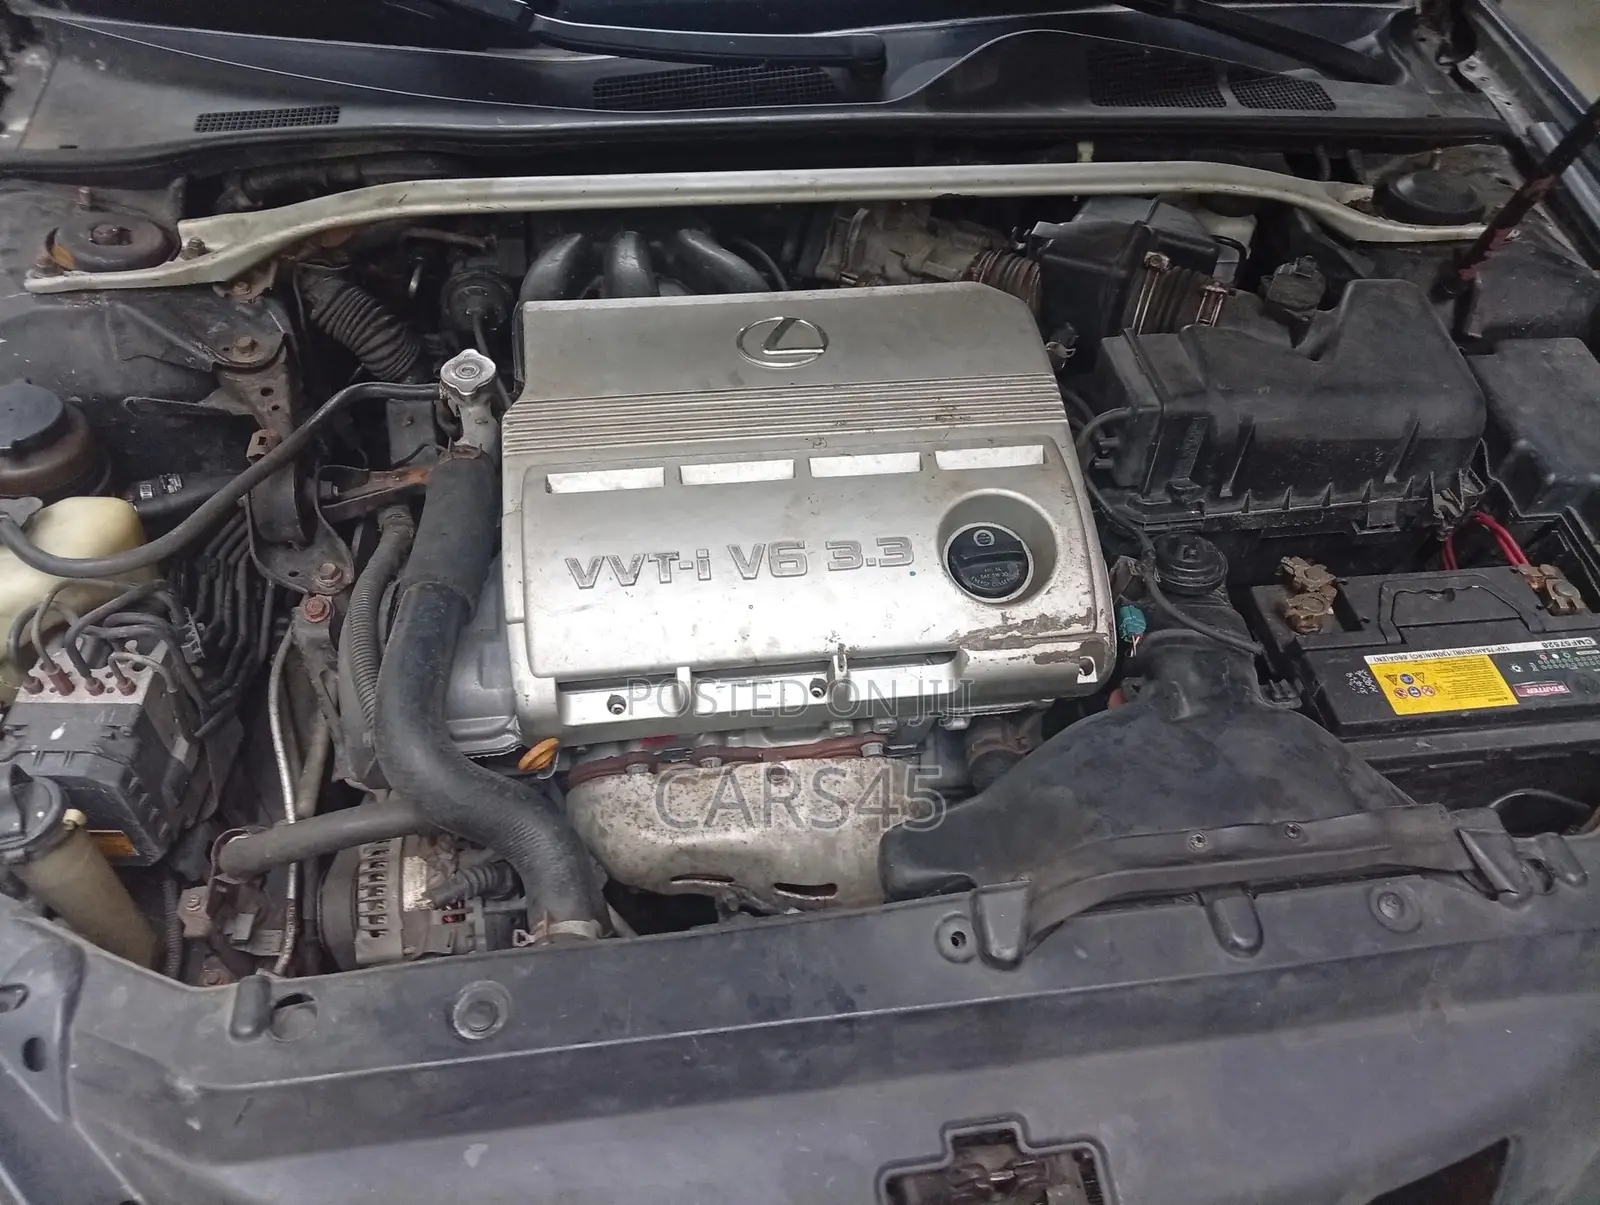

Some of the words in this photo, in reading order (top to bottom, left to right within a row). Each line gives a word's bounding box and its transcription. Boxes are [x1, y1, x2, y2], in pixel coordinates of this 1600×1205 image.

[564, 548, 712, 590] VVT-i
[726, 540, 808, 580] V6
[825, 535, 915, 572] 3.3
[1526, 685, 1566, 694] STARTER
